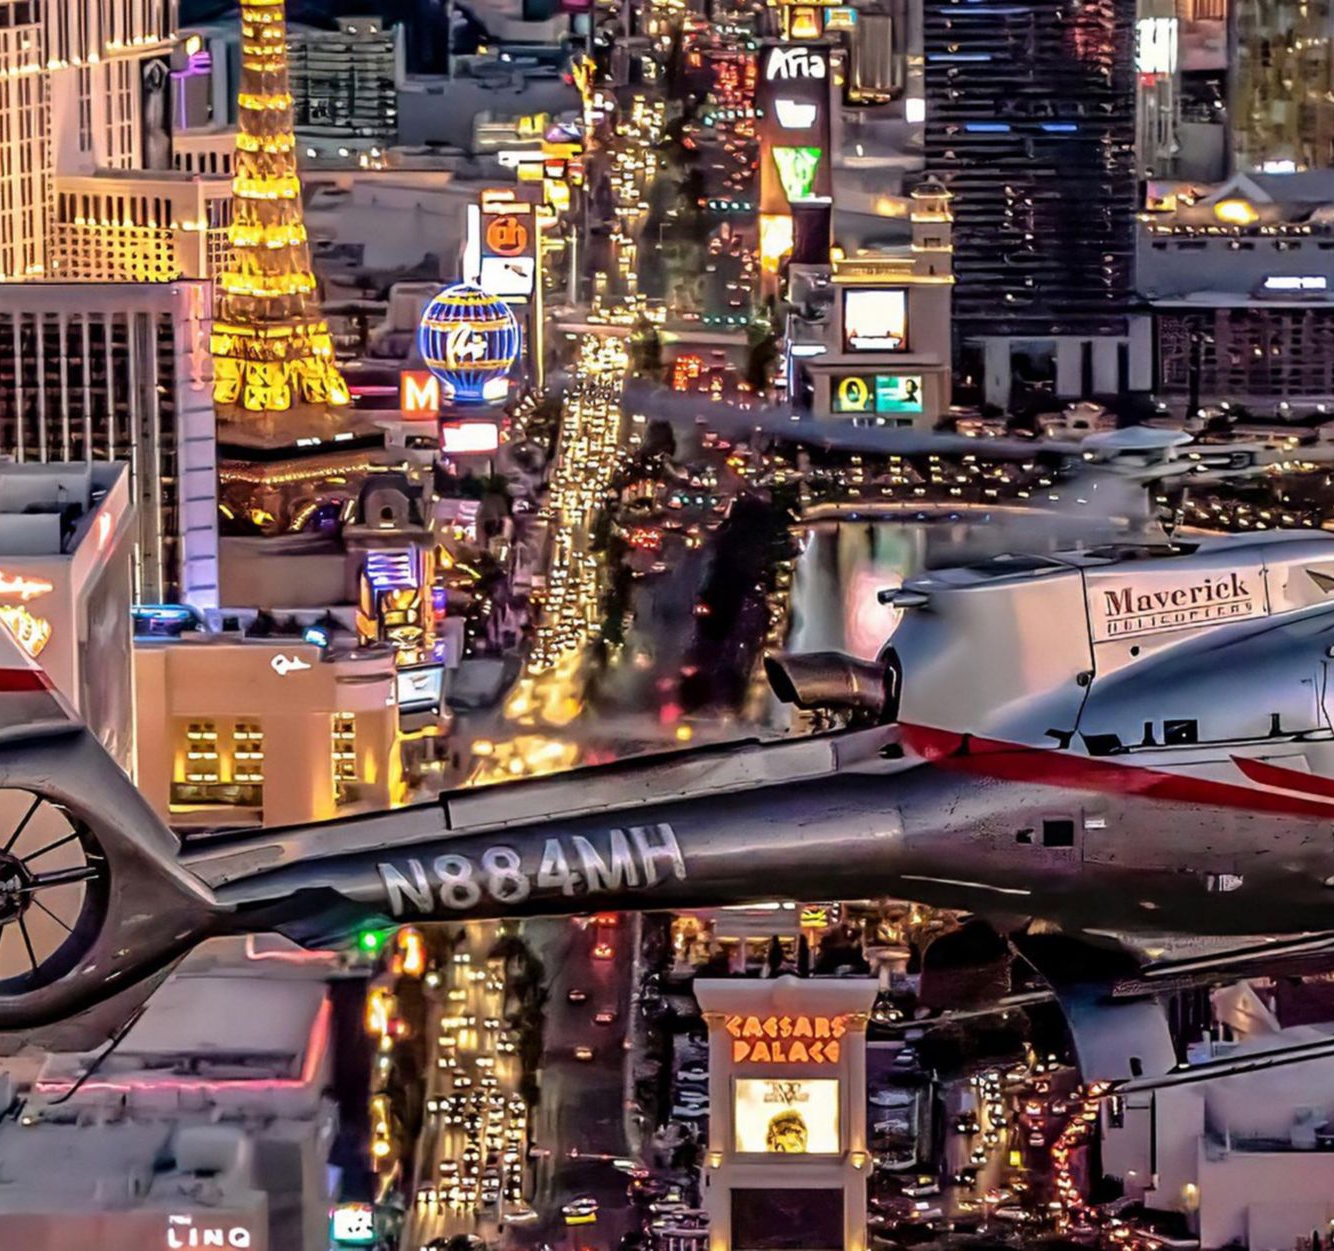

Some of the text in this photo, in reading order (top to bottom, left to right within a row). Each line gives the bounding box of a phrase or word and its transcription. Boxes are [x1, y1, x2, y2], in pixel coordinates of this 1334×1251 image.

[1104, 572, 1249, 617] Maverick
[378, 822, 686, 916] N884MH
[726, 1015, 846, 1038] CAESARS
[733, 1040, 840, 1063] PALACE
[167, 1226, 250, 1248] LINQ
